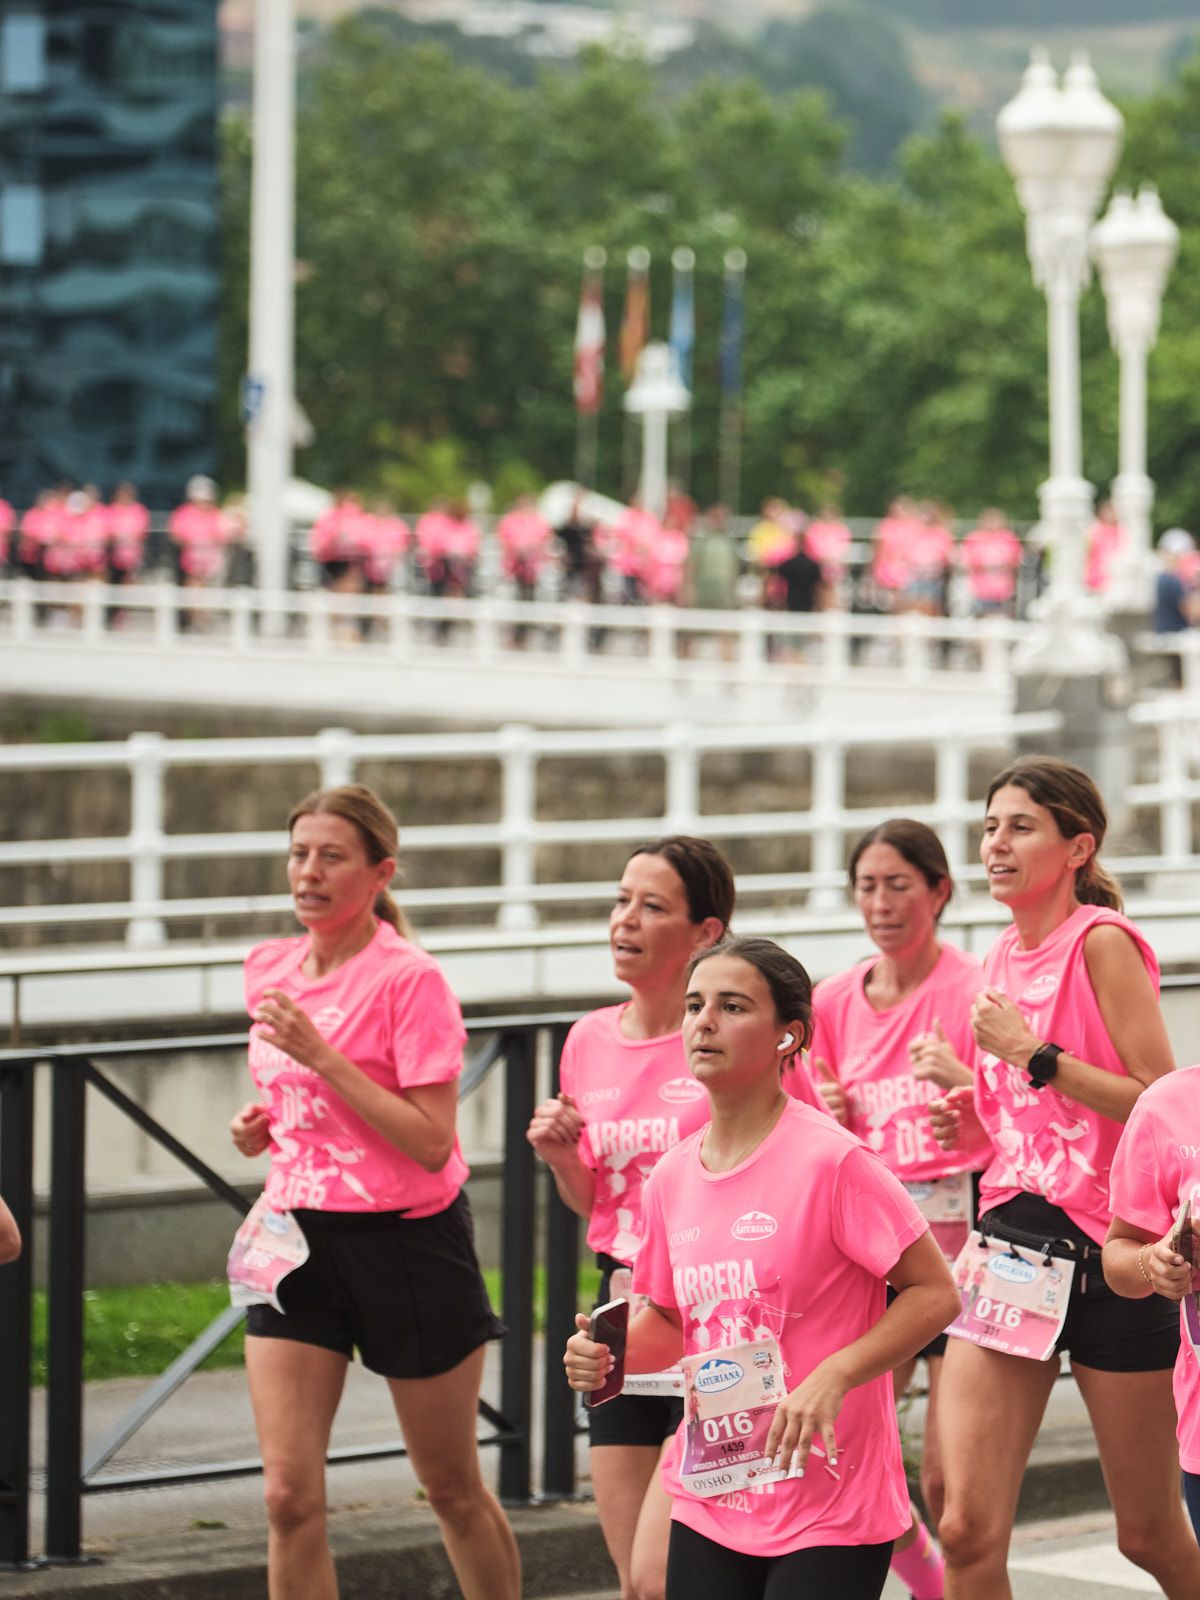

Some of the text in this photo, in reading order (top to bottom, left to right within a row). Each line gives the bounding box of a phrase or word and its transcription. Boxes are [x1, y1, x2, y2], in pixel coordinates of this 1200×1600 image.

[896, 1117, 935, 1166] DE
[670, 1226, 700, 1249] OYSHO
[975, 1297, 1024, 1328] 016
[698, 1370, 741, 1387] ASTURIANA
[703, 1411, 754, 1444] 016
[720, 1440, 745, 1455] 1439
[718, 1456, 729, 1467] DE
[729, 1454, 738, 1464] LA
[693, 1473, 732, 1490] OYSHO
